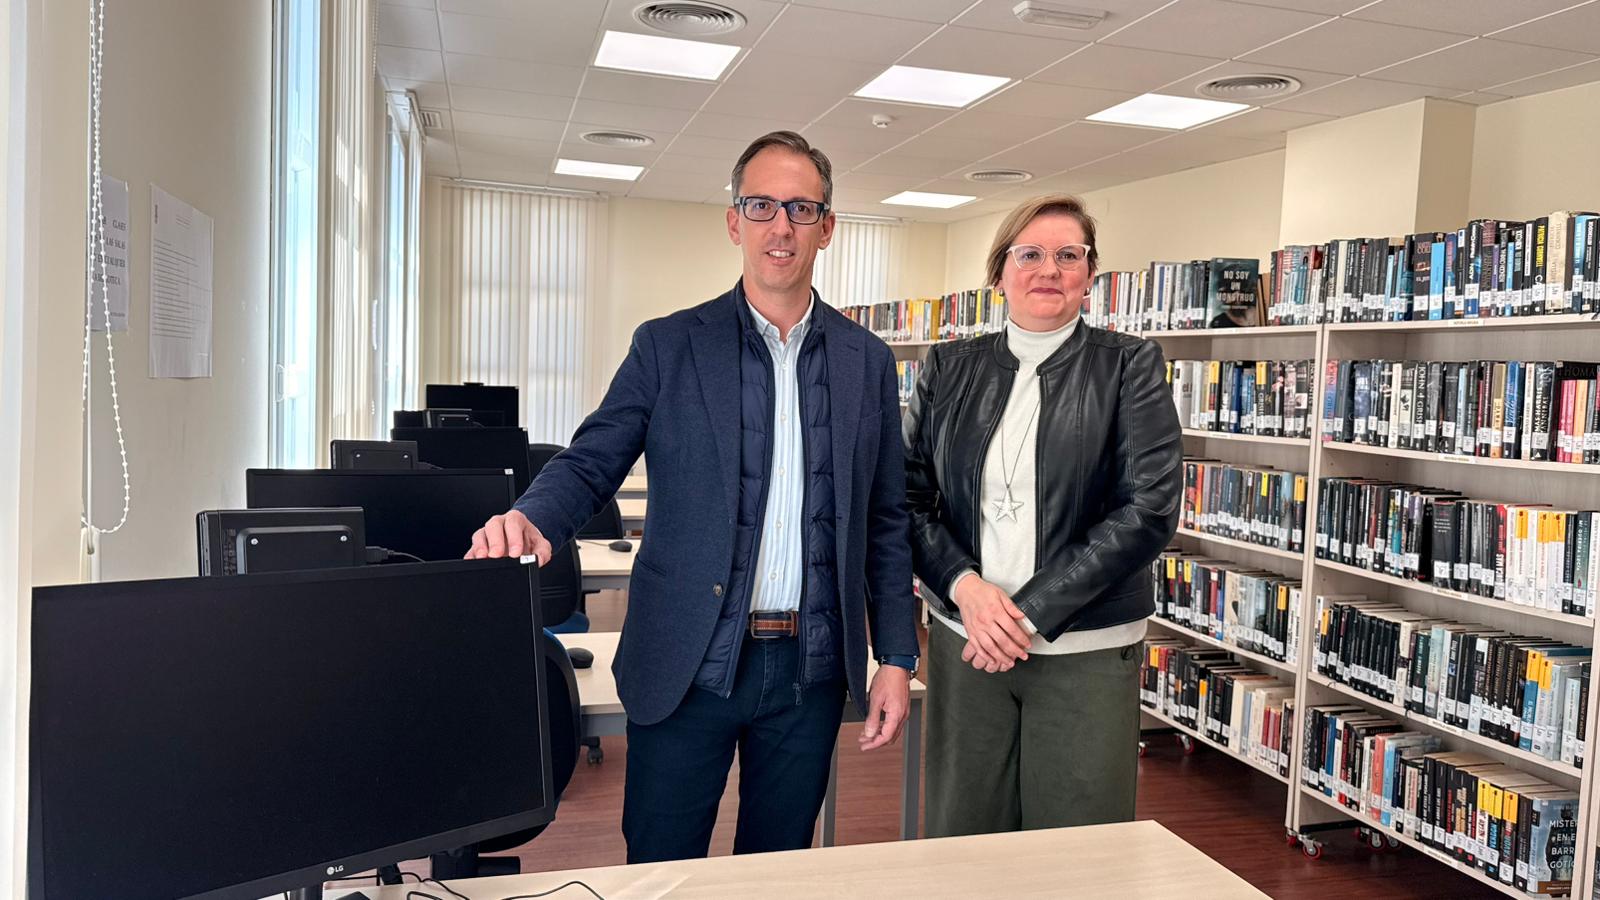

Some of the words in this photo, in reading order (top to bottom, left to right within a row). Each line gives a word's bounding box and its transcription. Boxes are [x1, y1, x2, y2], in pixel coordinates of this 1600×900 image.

[1536, 225, 1546, 245] PATRICIA
[1224, 271, 1234, 280] NO
[1236, 271, 1250, 280] SOY
[1231, 282, 1241, 291] UN
[1216, 293, 1254, 302] MONSTRUO
[1418, 366, 1426, 390] JOHN
[1557, 833, 1568, 841] EN
[1551, 847, 1575, 855] BARR
[335, 865, 344, 873] LG
